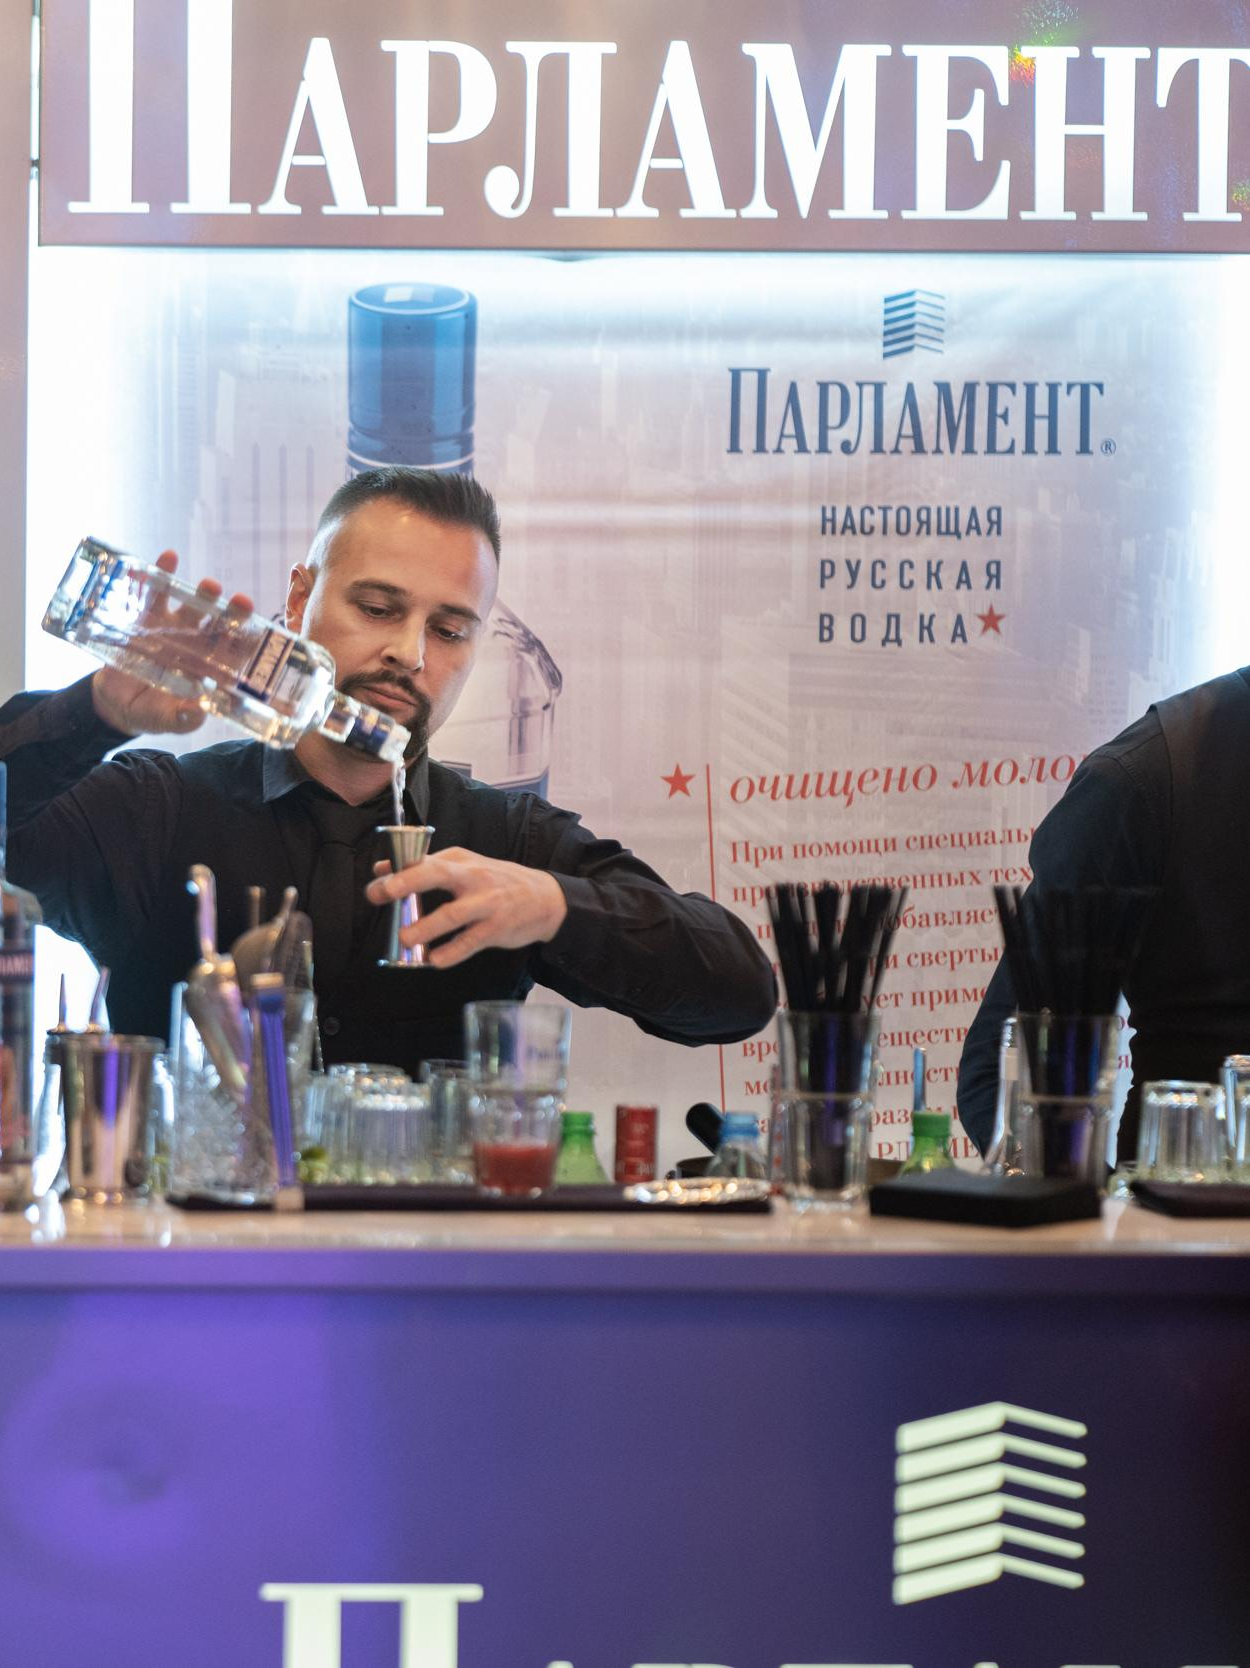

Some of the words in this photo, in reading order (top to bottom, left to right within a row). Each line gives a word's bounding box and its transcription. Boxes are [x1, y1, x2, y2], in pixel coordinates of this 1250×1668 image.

[67, 0, 1250, 223] ПАРЛАМЕНТ
[820, 505, 1003, 541] НАСТОЯЩАЯ
[819, 559, 1003, 591] РУССКАЯ
[818, 613, 968, 647] ВОДКА
[729, 763, 939, 808] очищено
[951, 752, 1088, 790] моло
[729, 839, 784, 868] При
[792, 837, 898, 858] помощи
[878, 903, 999, 931] обавляе
[906, 944, 1006, 972] сверты
